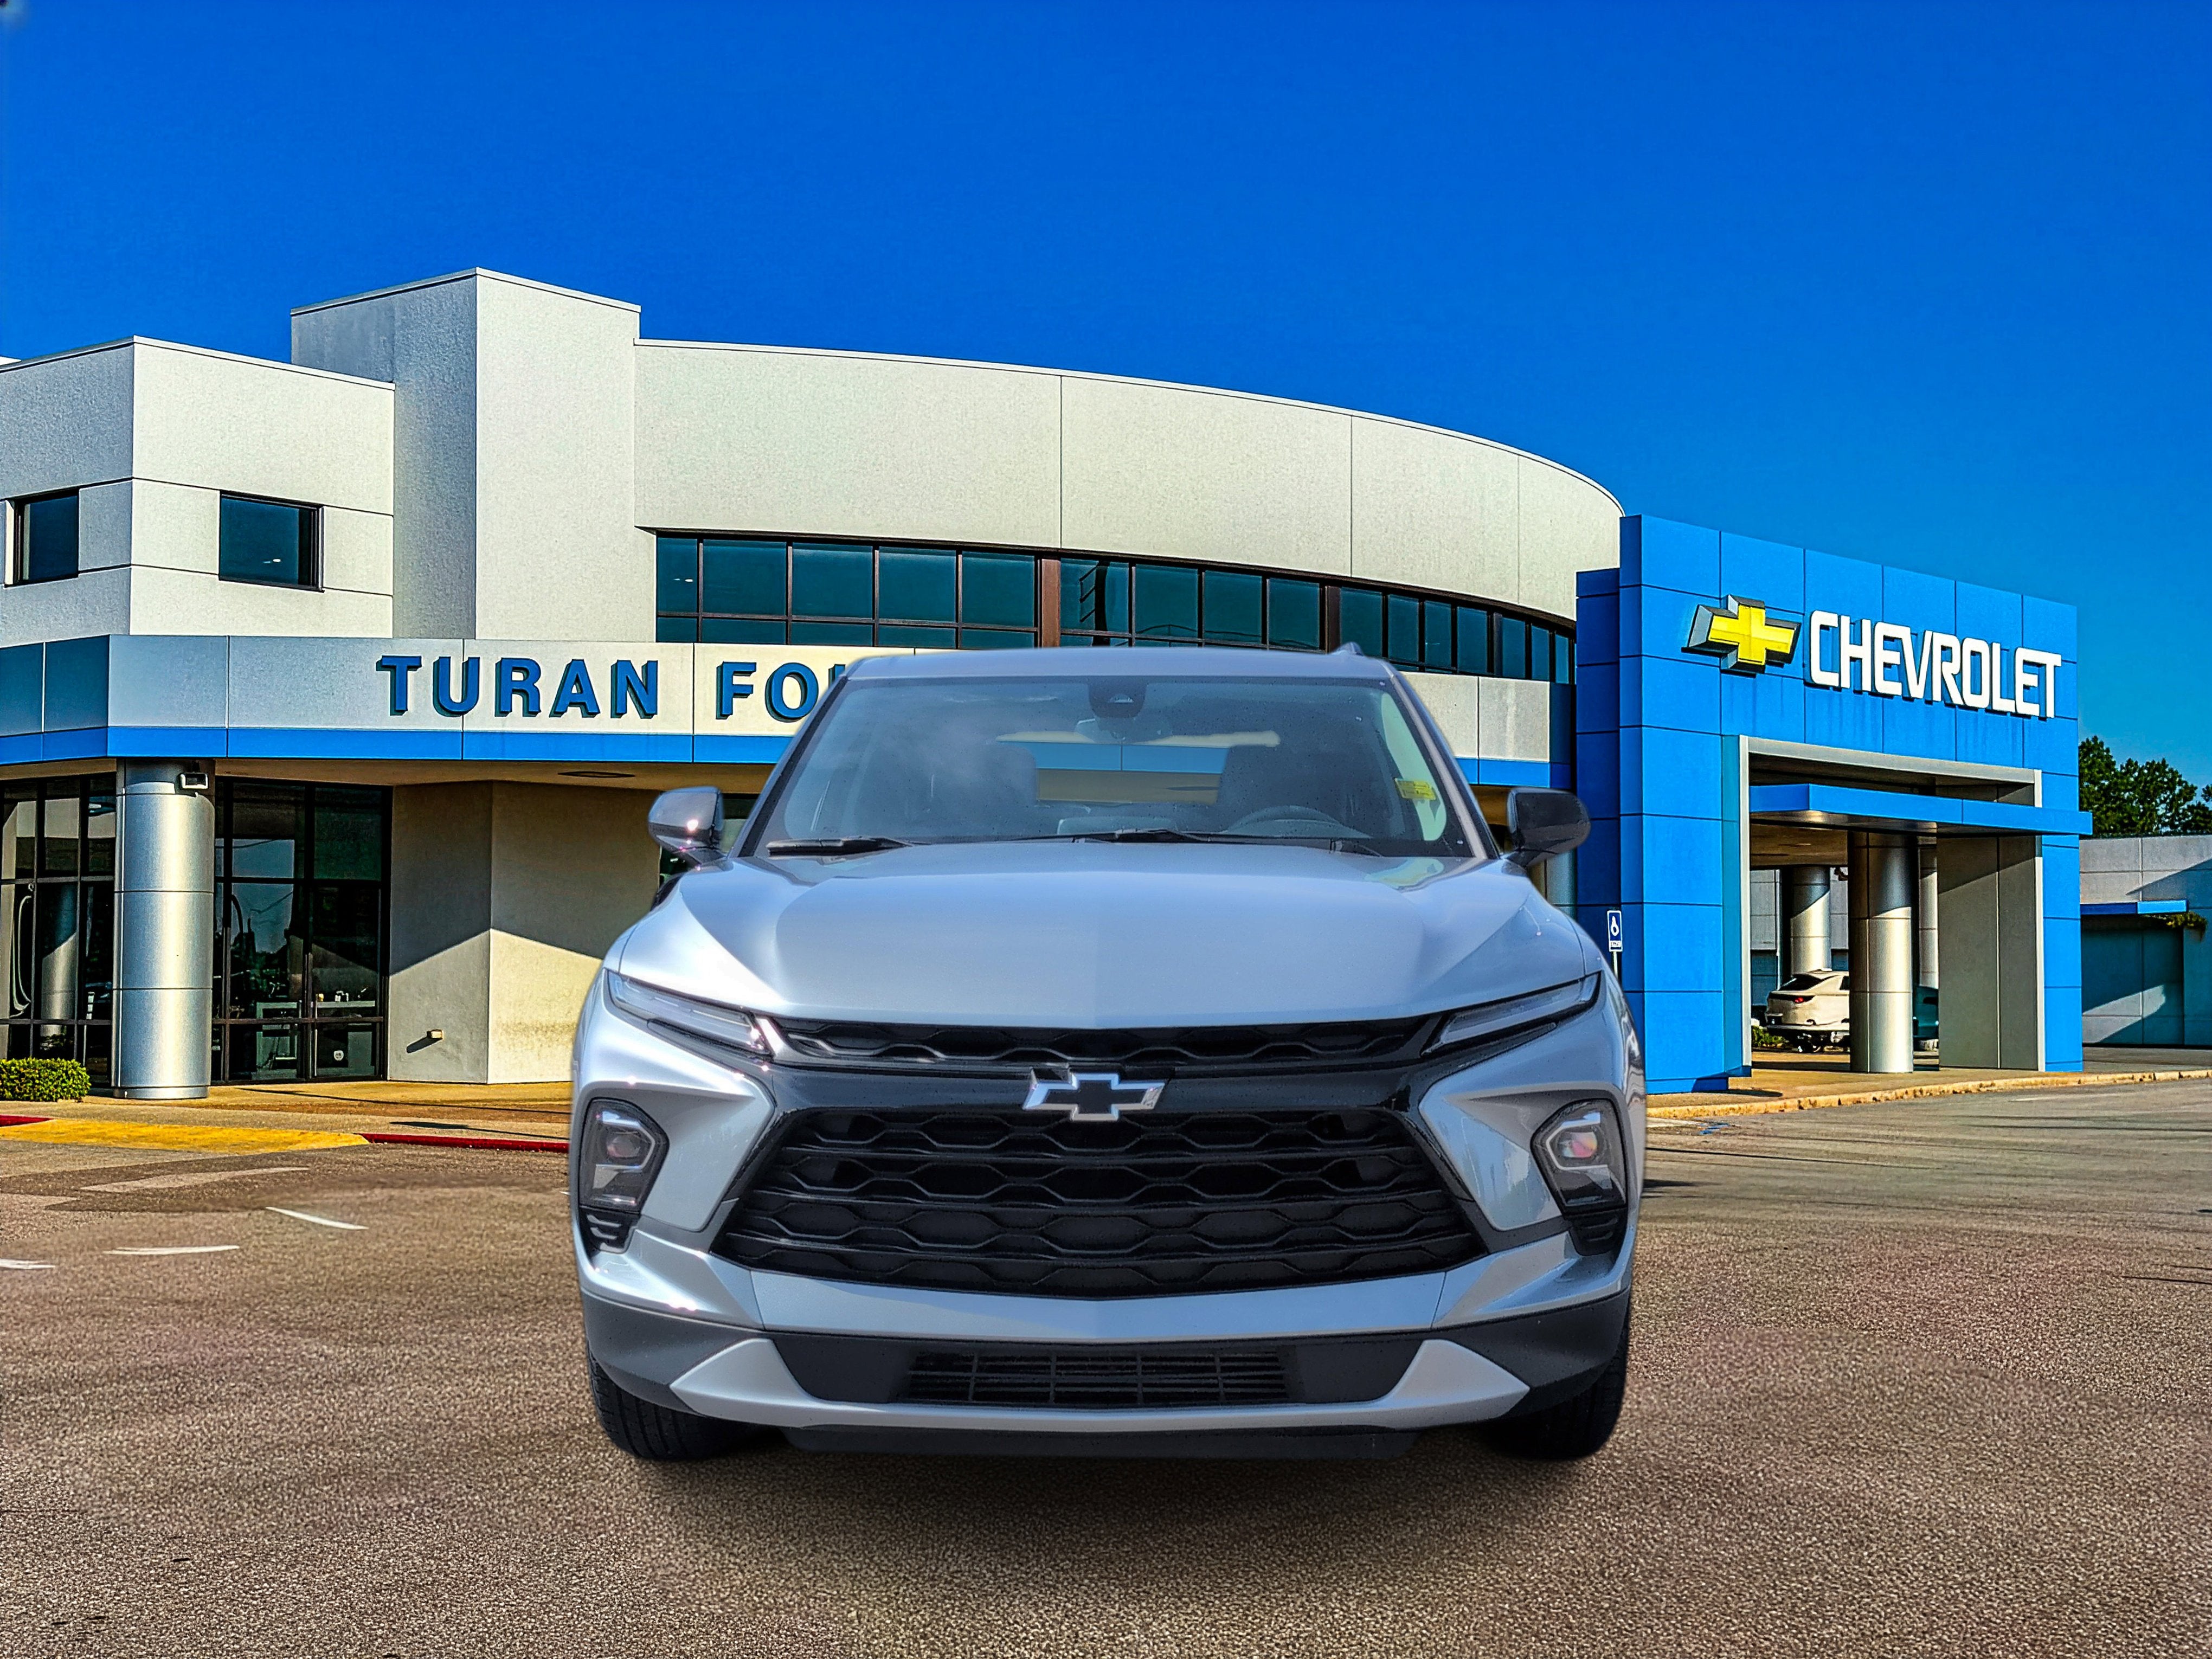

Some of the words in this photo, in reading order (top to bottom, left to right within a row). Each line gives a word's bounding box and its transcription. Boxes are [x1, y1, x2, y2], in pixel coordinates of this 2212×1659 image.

[376, 655, 658, 719] TURAN
[716, 661, 846, 723] FO
[1810, 610, 2062, 719] CHEVROLET
